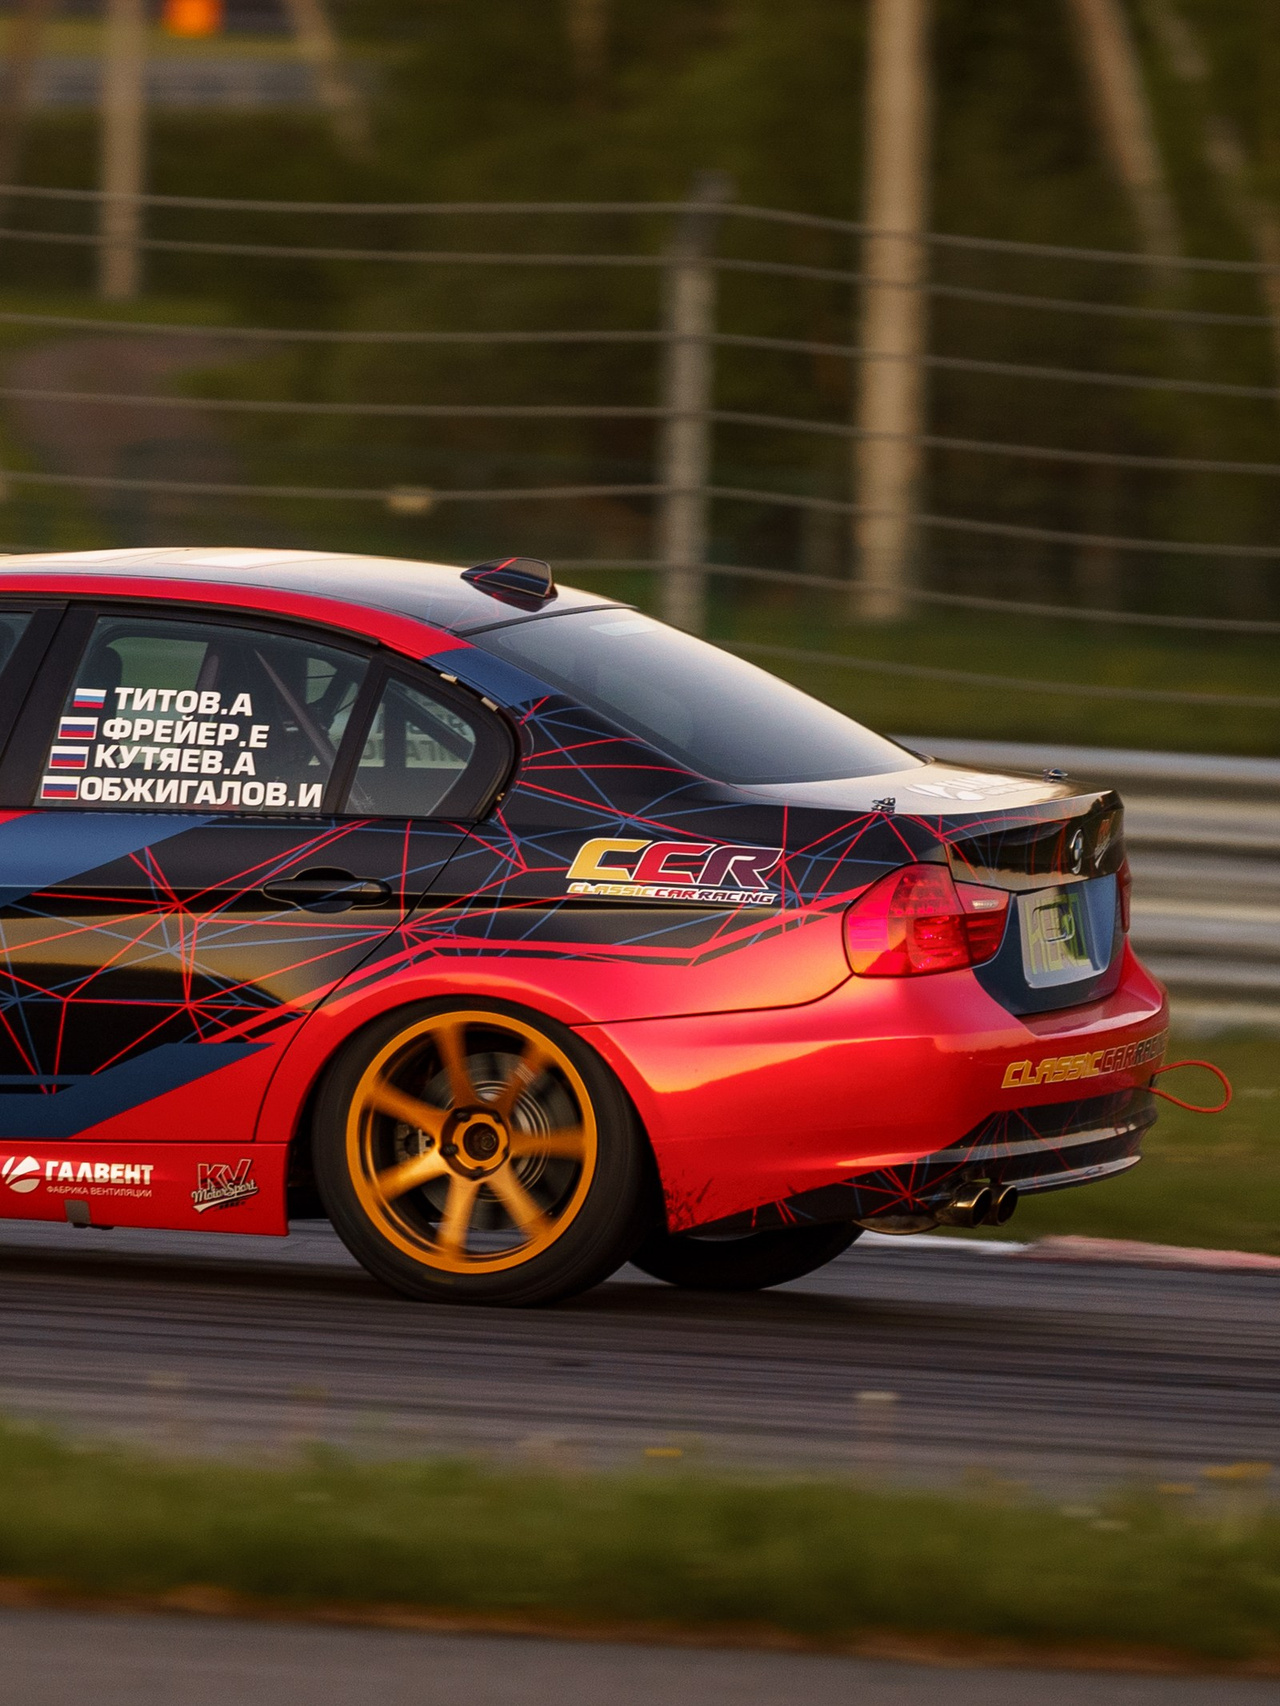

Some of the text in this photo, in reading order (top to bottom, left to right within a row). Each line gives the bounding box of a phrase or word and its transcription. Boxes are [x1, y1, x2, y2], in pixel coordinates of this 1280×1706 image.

[114, 687, 253, 716] ТИТОВ.А
[102, 715, 269, 748] ФРЕЙЕР.Е
[94, 744, 256, 776] КУТЯЕВ.А
[80, 776, 322, 808] ОБЖИГАЛОВ.И
[565, 837, 784, 890] CCR
[45, 1160, 154, 1186] ГАЛВЕНТ
[198, 1158, 252, 1191] KV
[46, 1185, 89, 1195] ФАБРИКА
